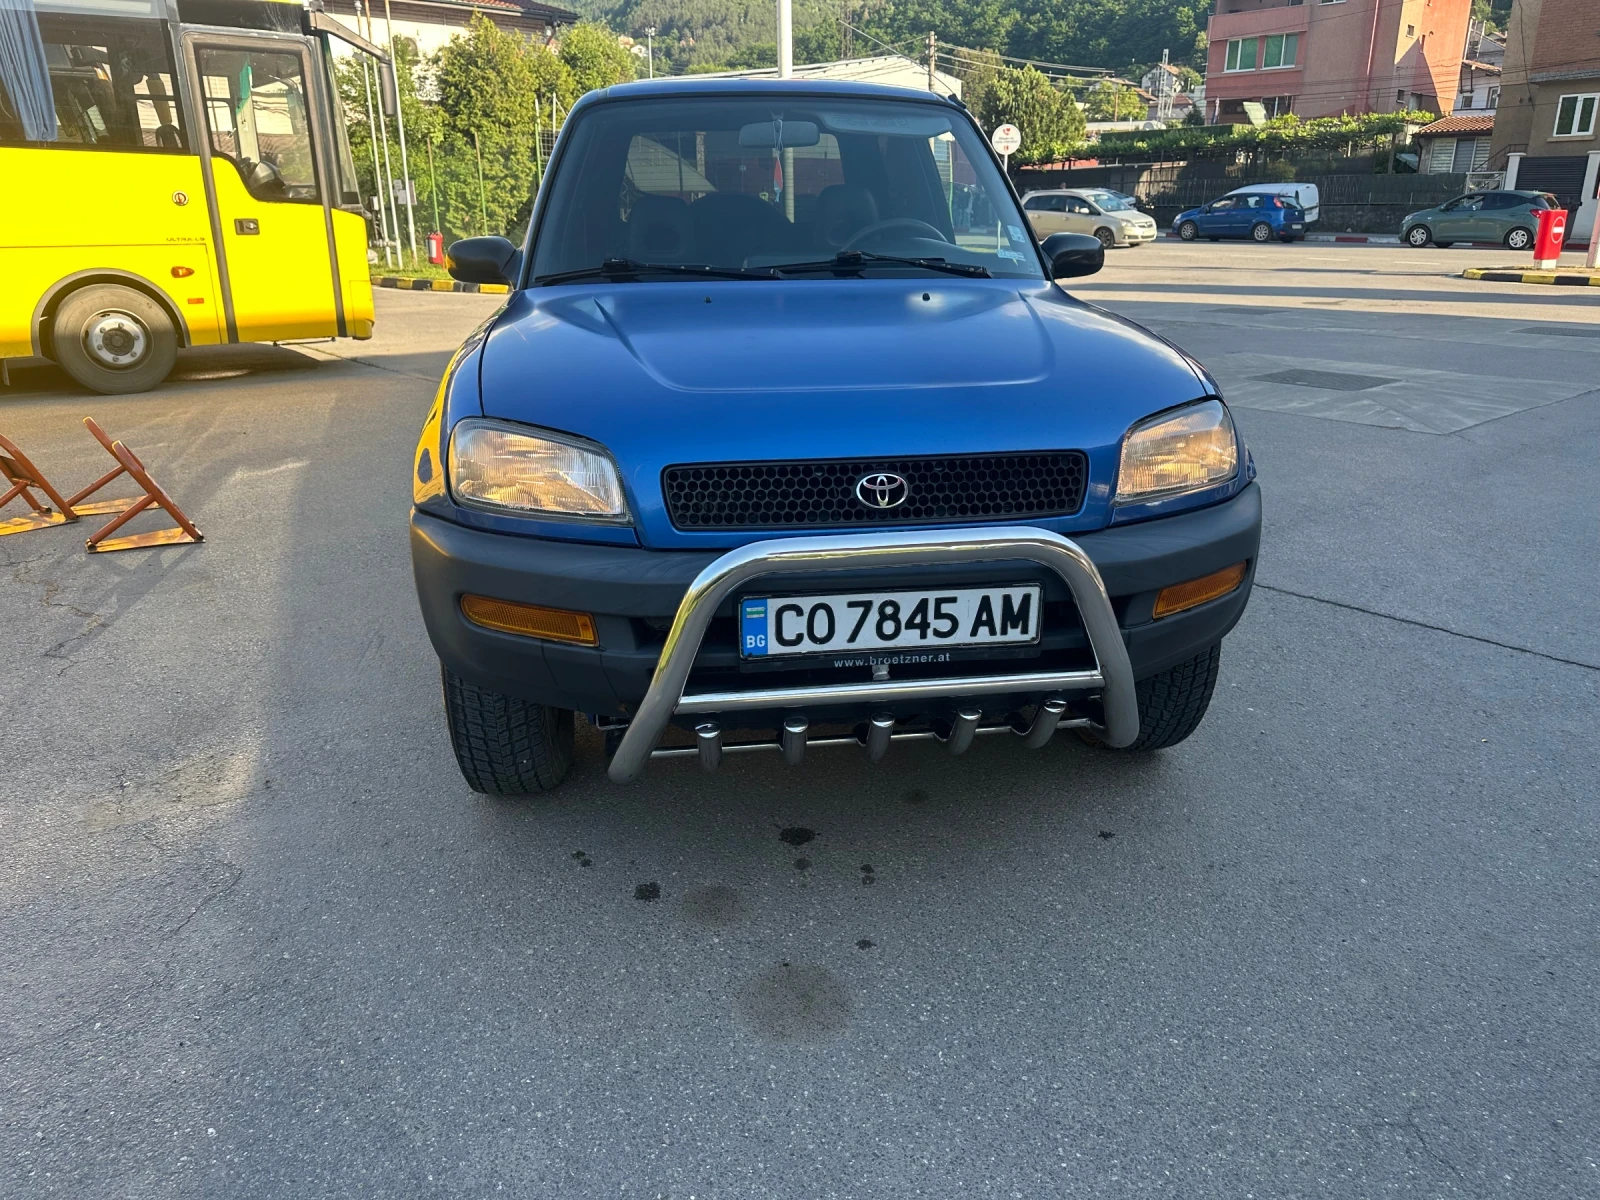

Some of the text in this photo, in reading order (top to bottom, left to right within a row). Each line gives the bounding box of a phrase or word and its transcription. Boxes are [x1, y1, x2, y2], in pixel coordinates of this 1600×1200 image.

[774, 592, 1032, 647] CO 7845 AM
[746, 634, 766, 649] BG
[833, 651, 951, 668] www.broetzner.at
